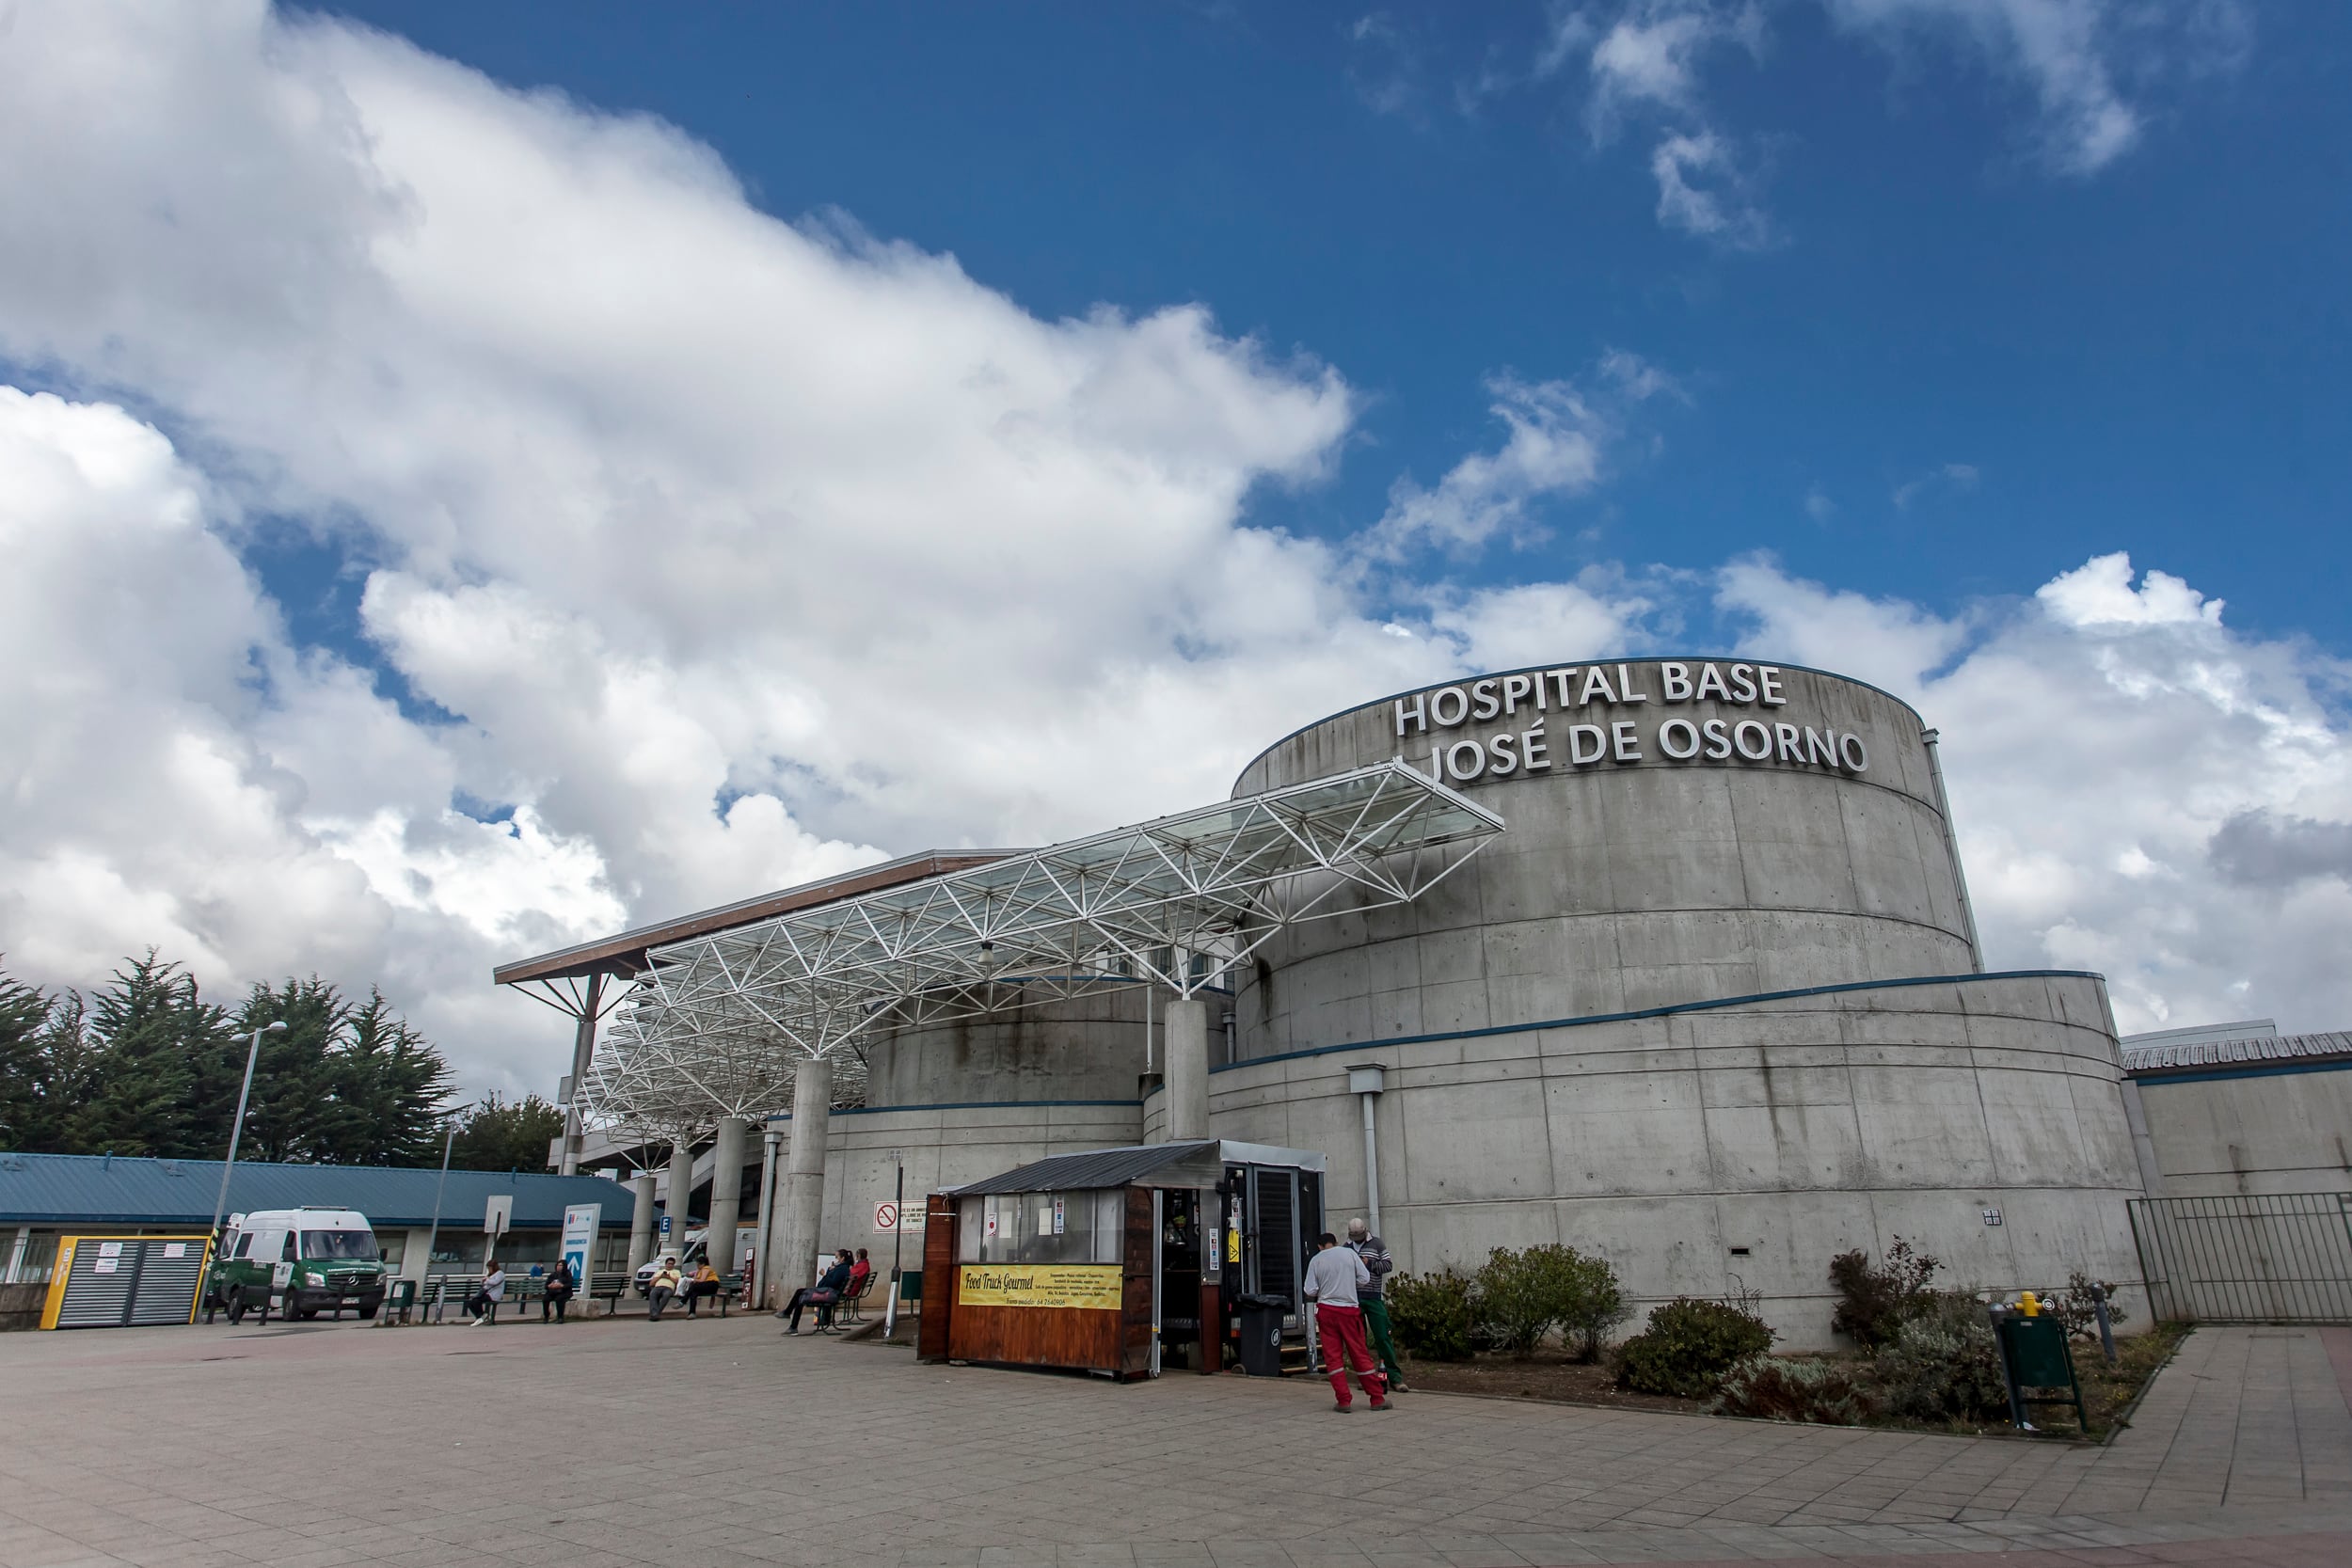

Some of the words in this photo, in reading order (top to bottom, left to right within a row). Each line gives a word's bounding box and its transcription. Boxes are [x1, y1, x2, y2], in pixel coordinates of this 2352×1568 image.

[1394, 663, 1646, 736] HOSPITAL
[1660, 661, 1788, 706] BASE
[1431, 717, 1551, 783] JOSÉ
[1568, 720, 1643, 766] DE
[1657, 718, 1868, 774] OSORNO
[662, 1218, 669, 1230] E
[965, 1273, 981, 1290] Food
[982, 1273, 1002, 1290] Truck
[1003, 1273, 1034, 1294] Gourmet
